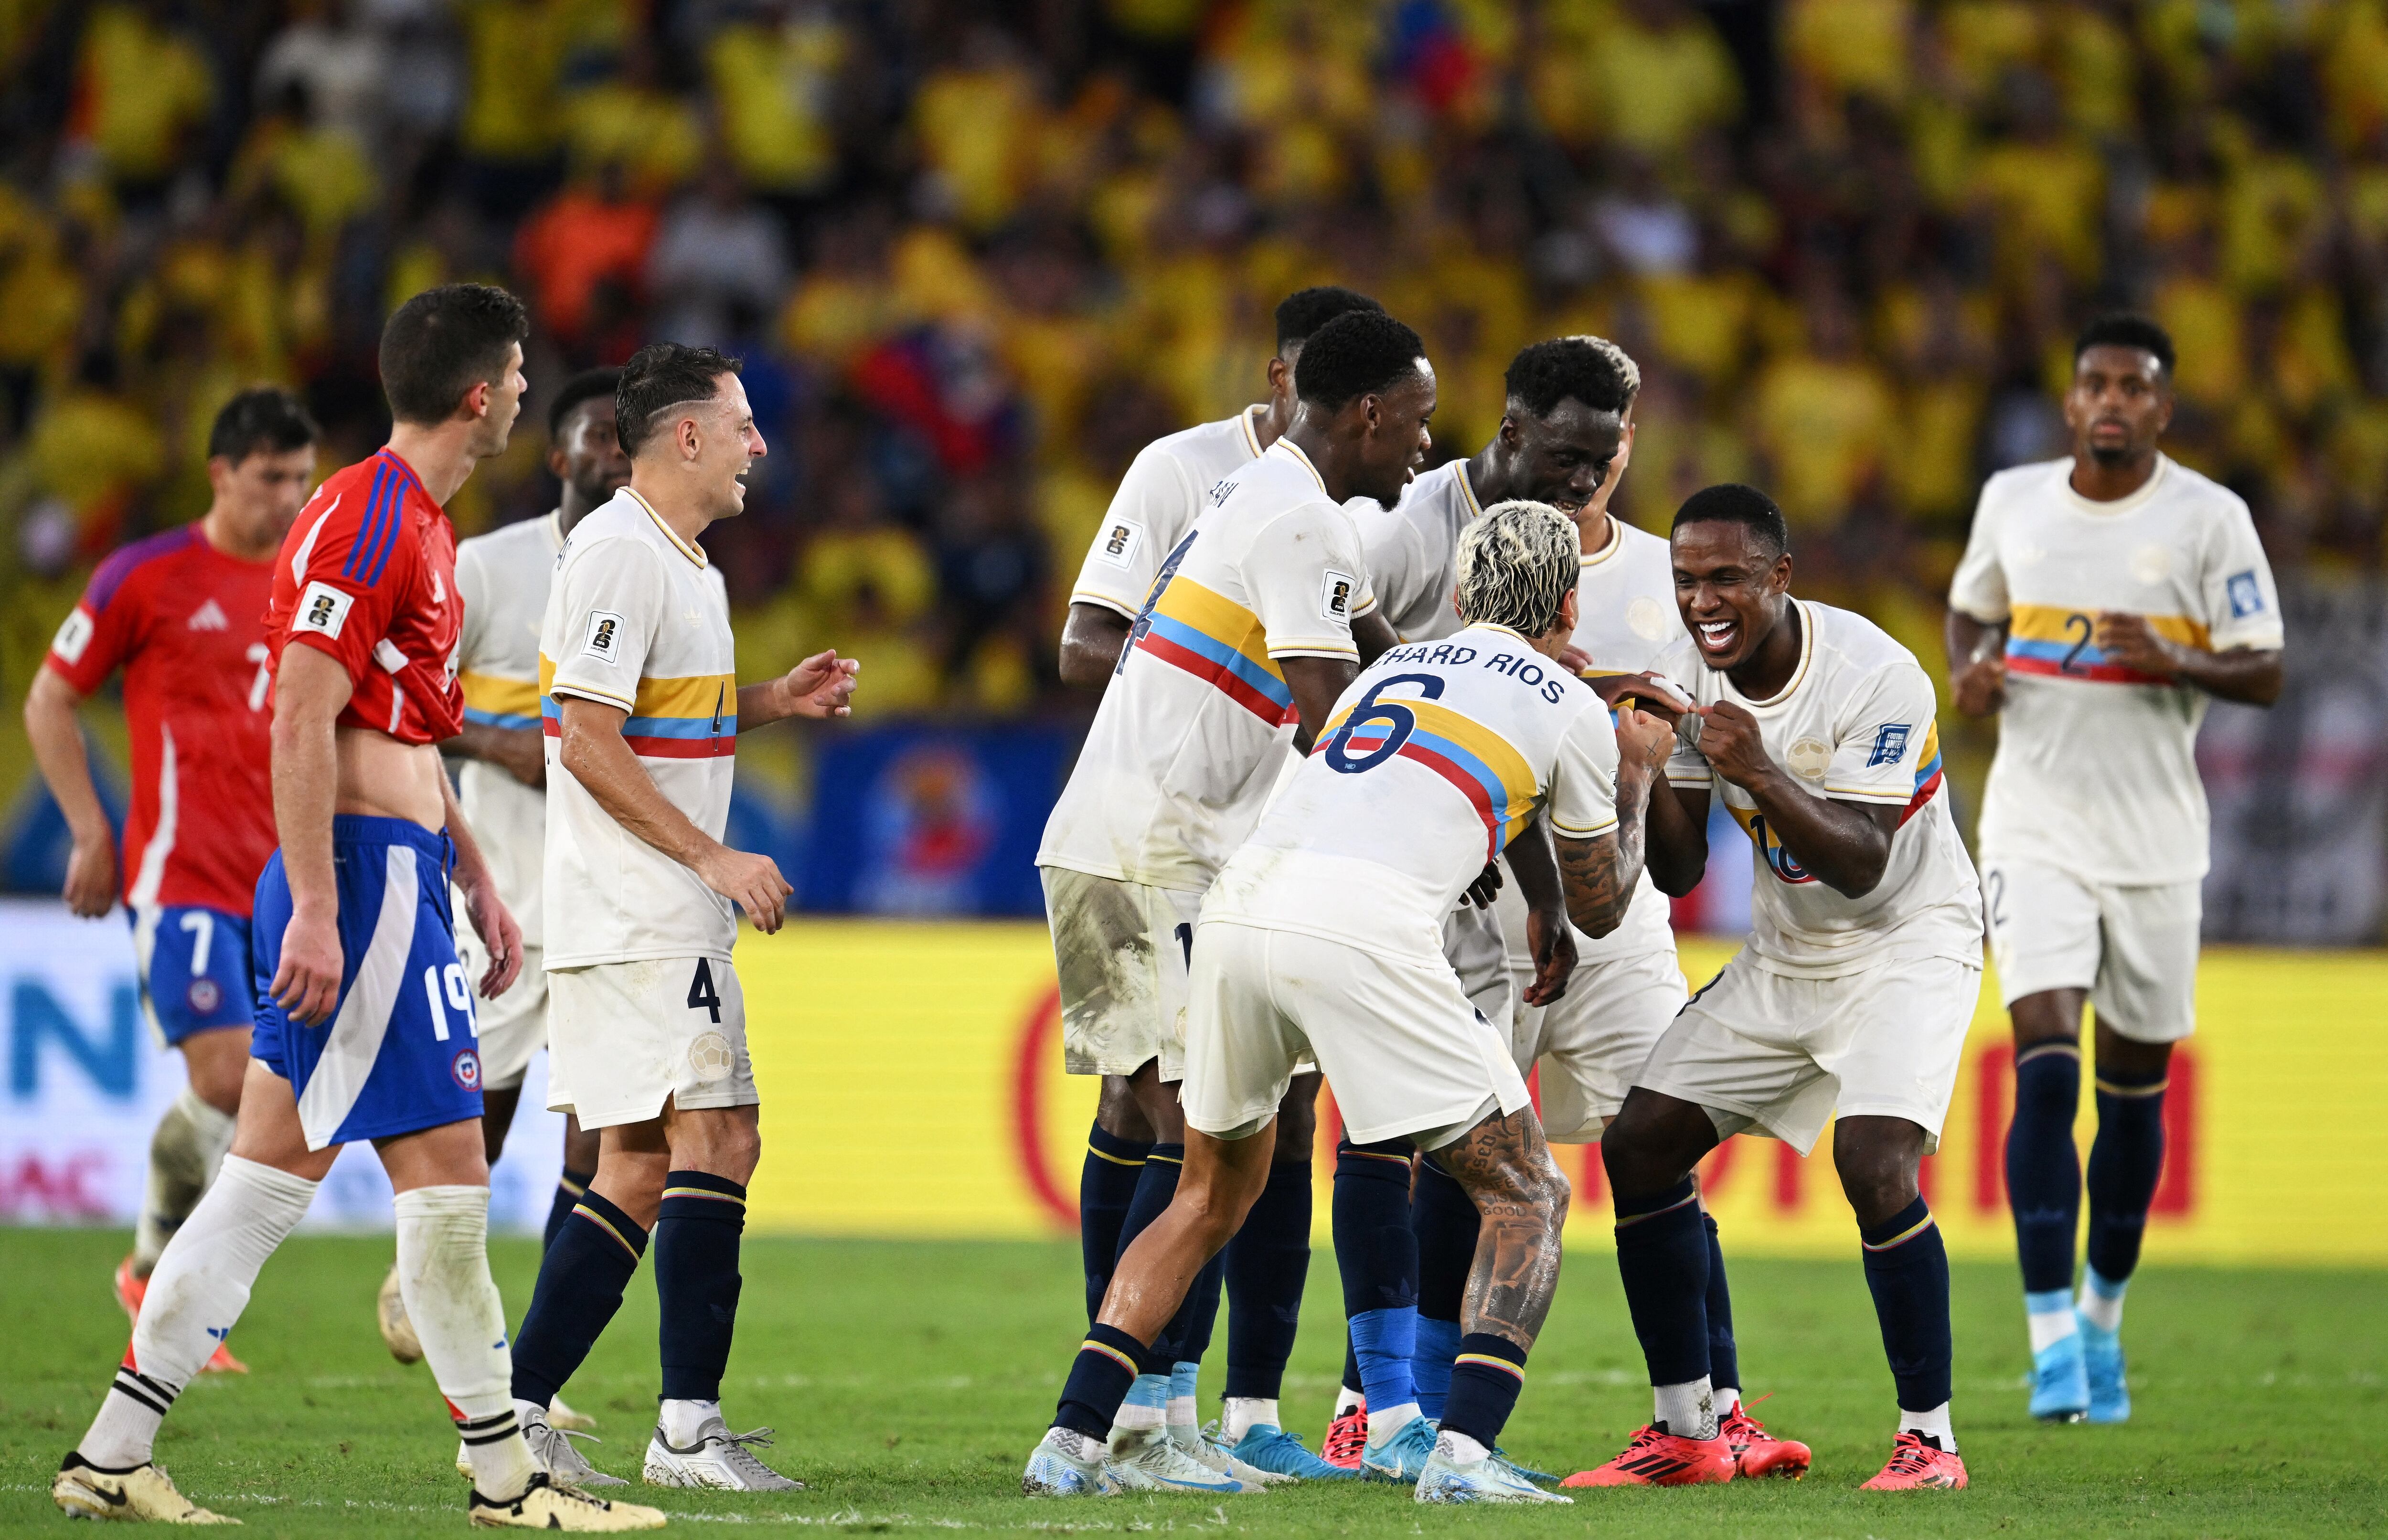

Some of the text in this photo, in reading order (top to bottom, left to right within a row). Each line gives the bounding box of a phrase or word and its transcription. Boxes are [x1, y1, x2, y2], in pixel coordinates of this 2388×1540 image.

[1484, 653, 1565, 704] RIOS
[712, 680, 724, 751] 4
[1325, 673, 1445, 774] 6
[180, 910, 214, 977] 7
[424, 963, 478, 1042] 19
[687, 957, 721, 1023] 4
[1484, 1206, 1526, 1216] GOOD
